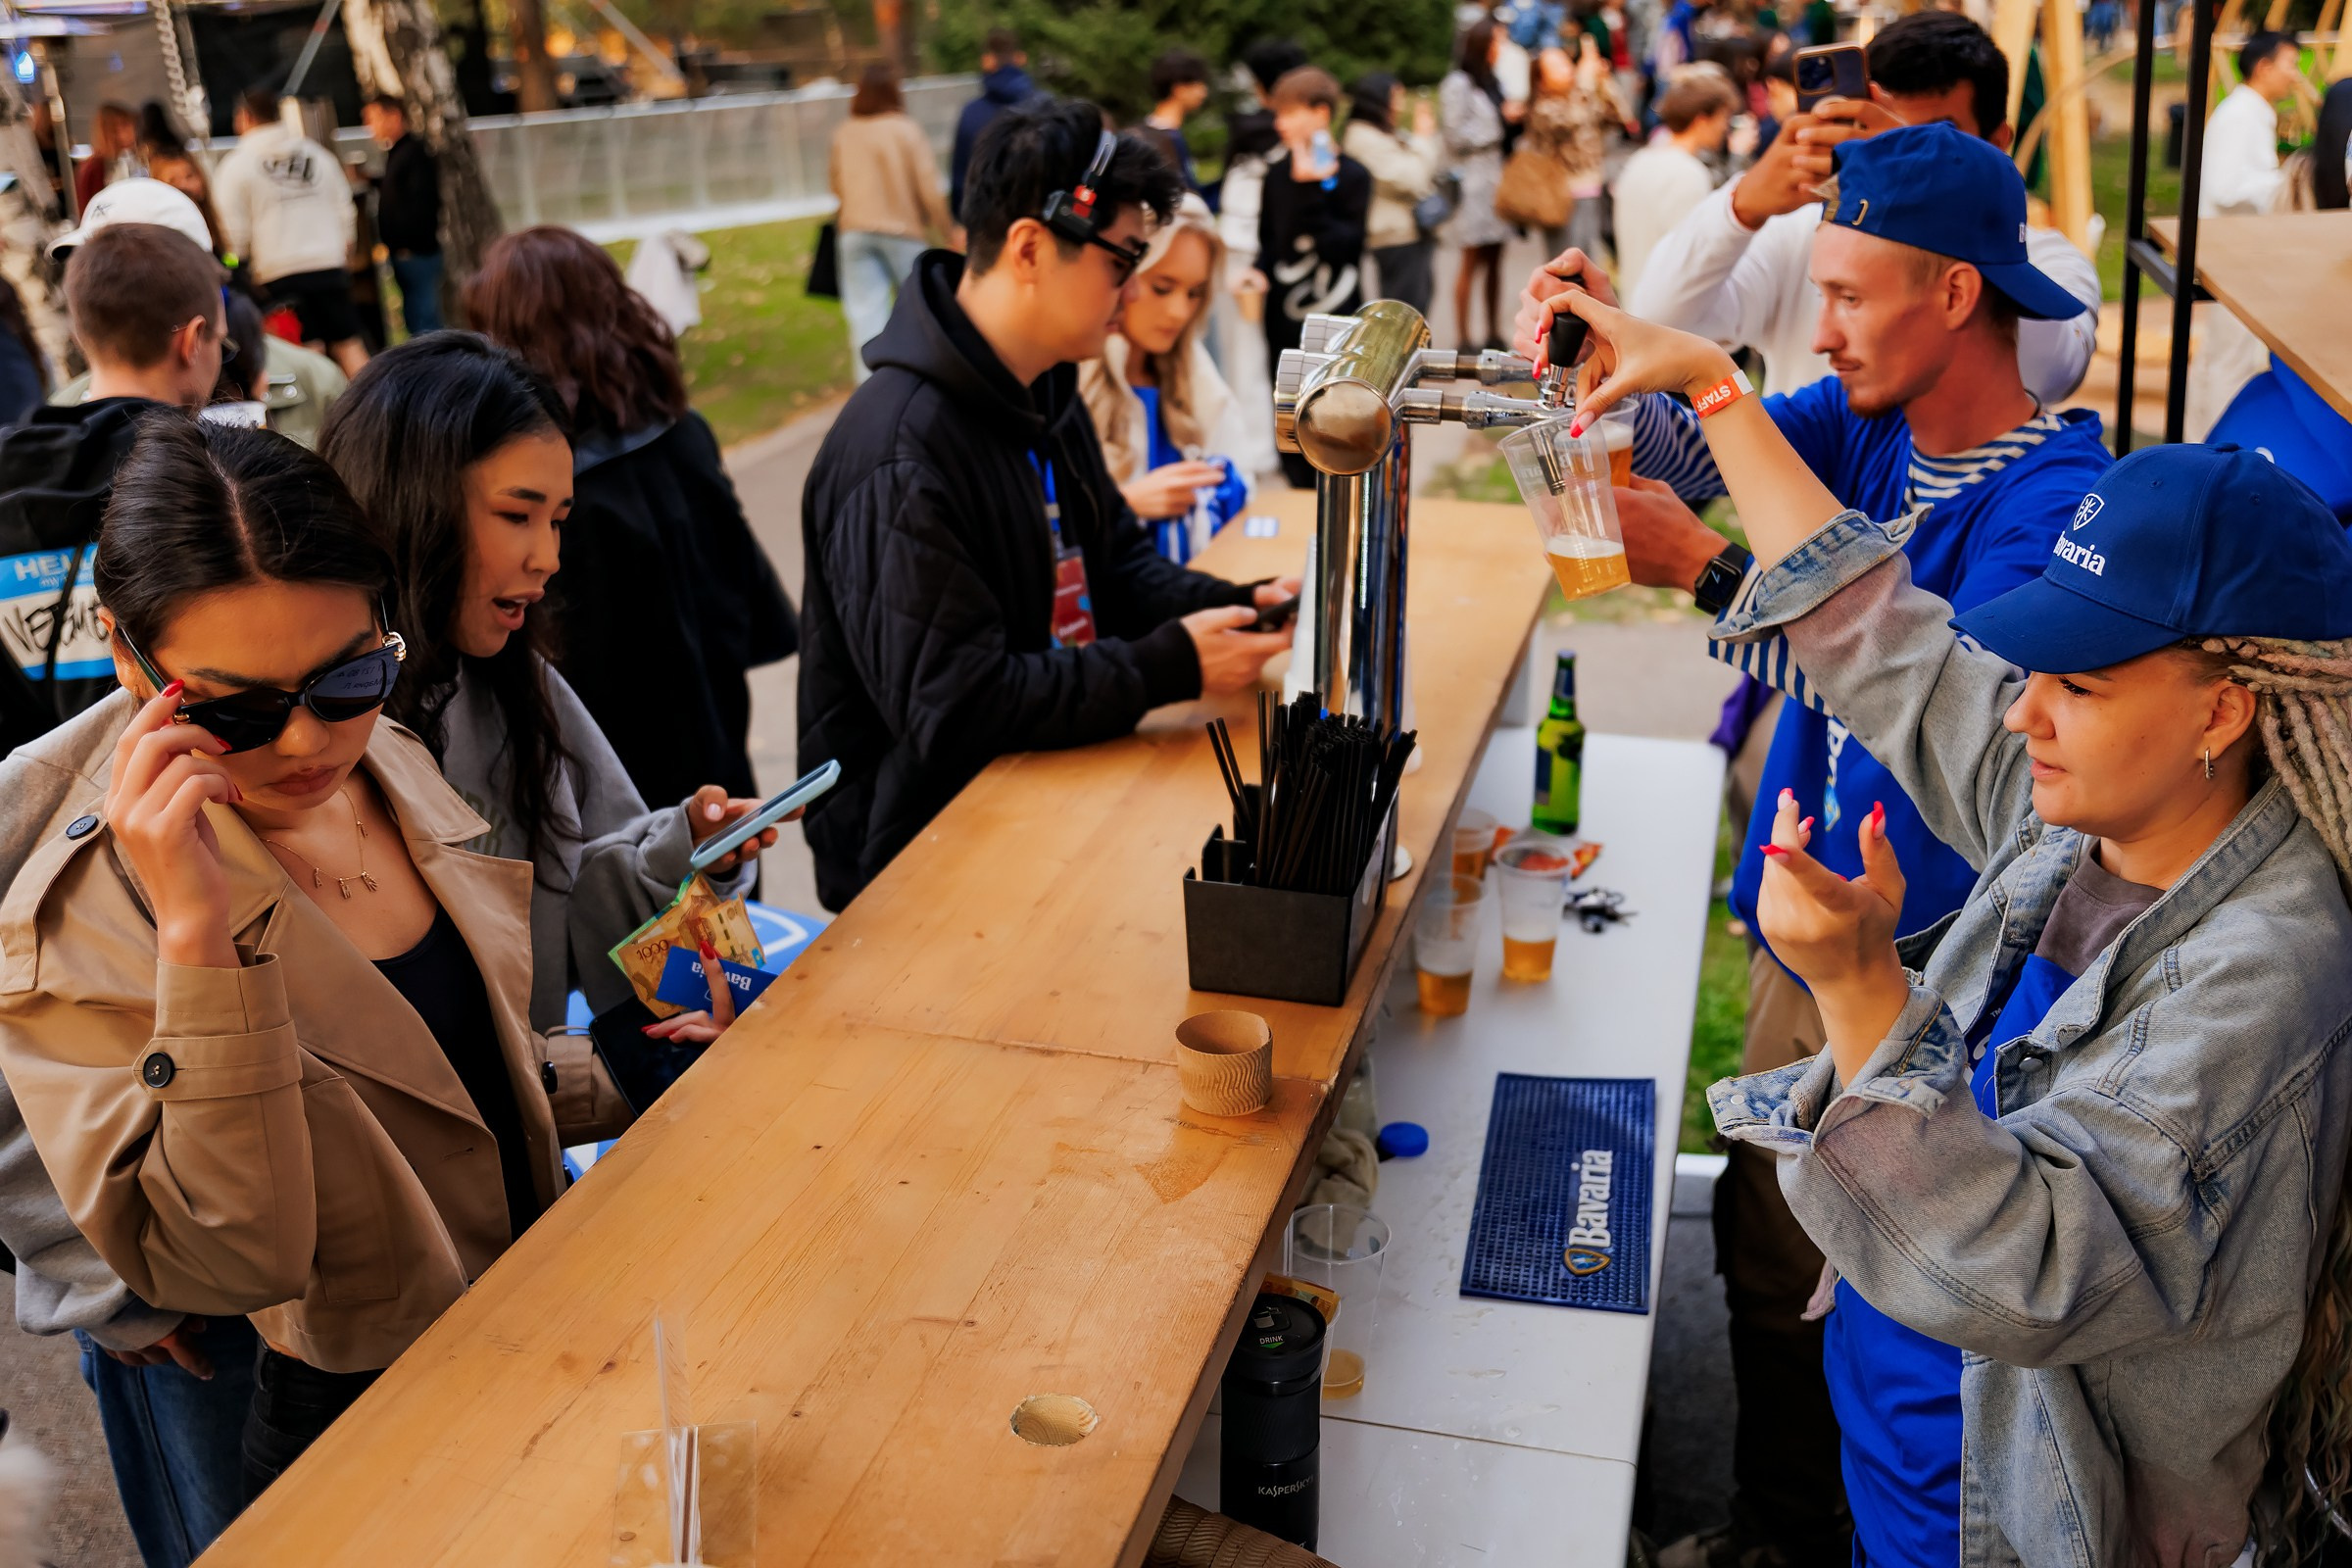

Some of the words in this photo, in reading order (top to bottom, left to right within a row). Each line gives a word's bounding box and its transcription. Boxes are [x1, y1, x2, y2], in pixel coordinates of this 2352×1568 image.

[1696, 385, 1732, 413] STAFF
[636, 939, 669, 961] 1000
[691, 961, 752, 991] Bavia
[1569, 1150, 1613, 1248] Bavaria
[1259, 1335, 1284, 1345] DRINK
